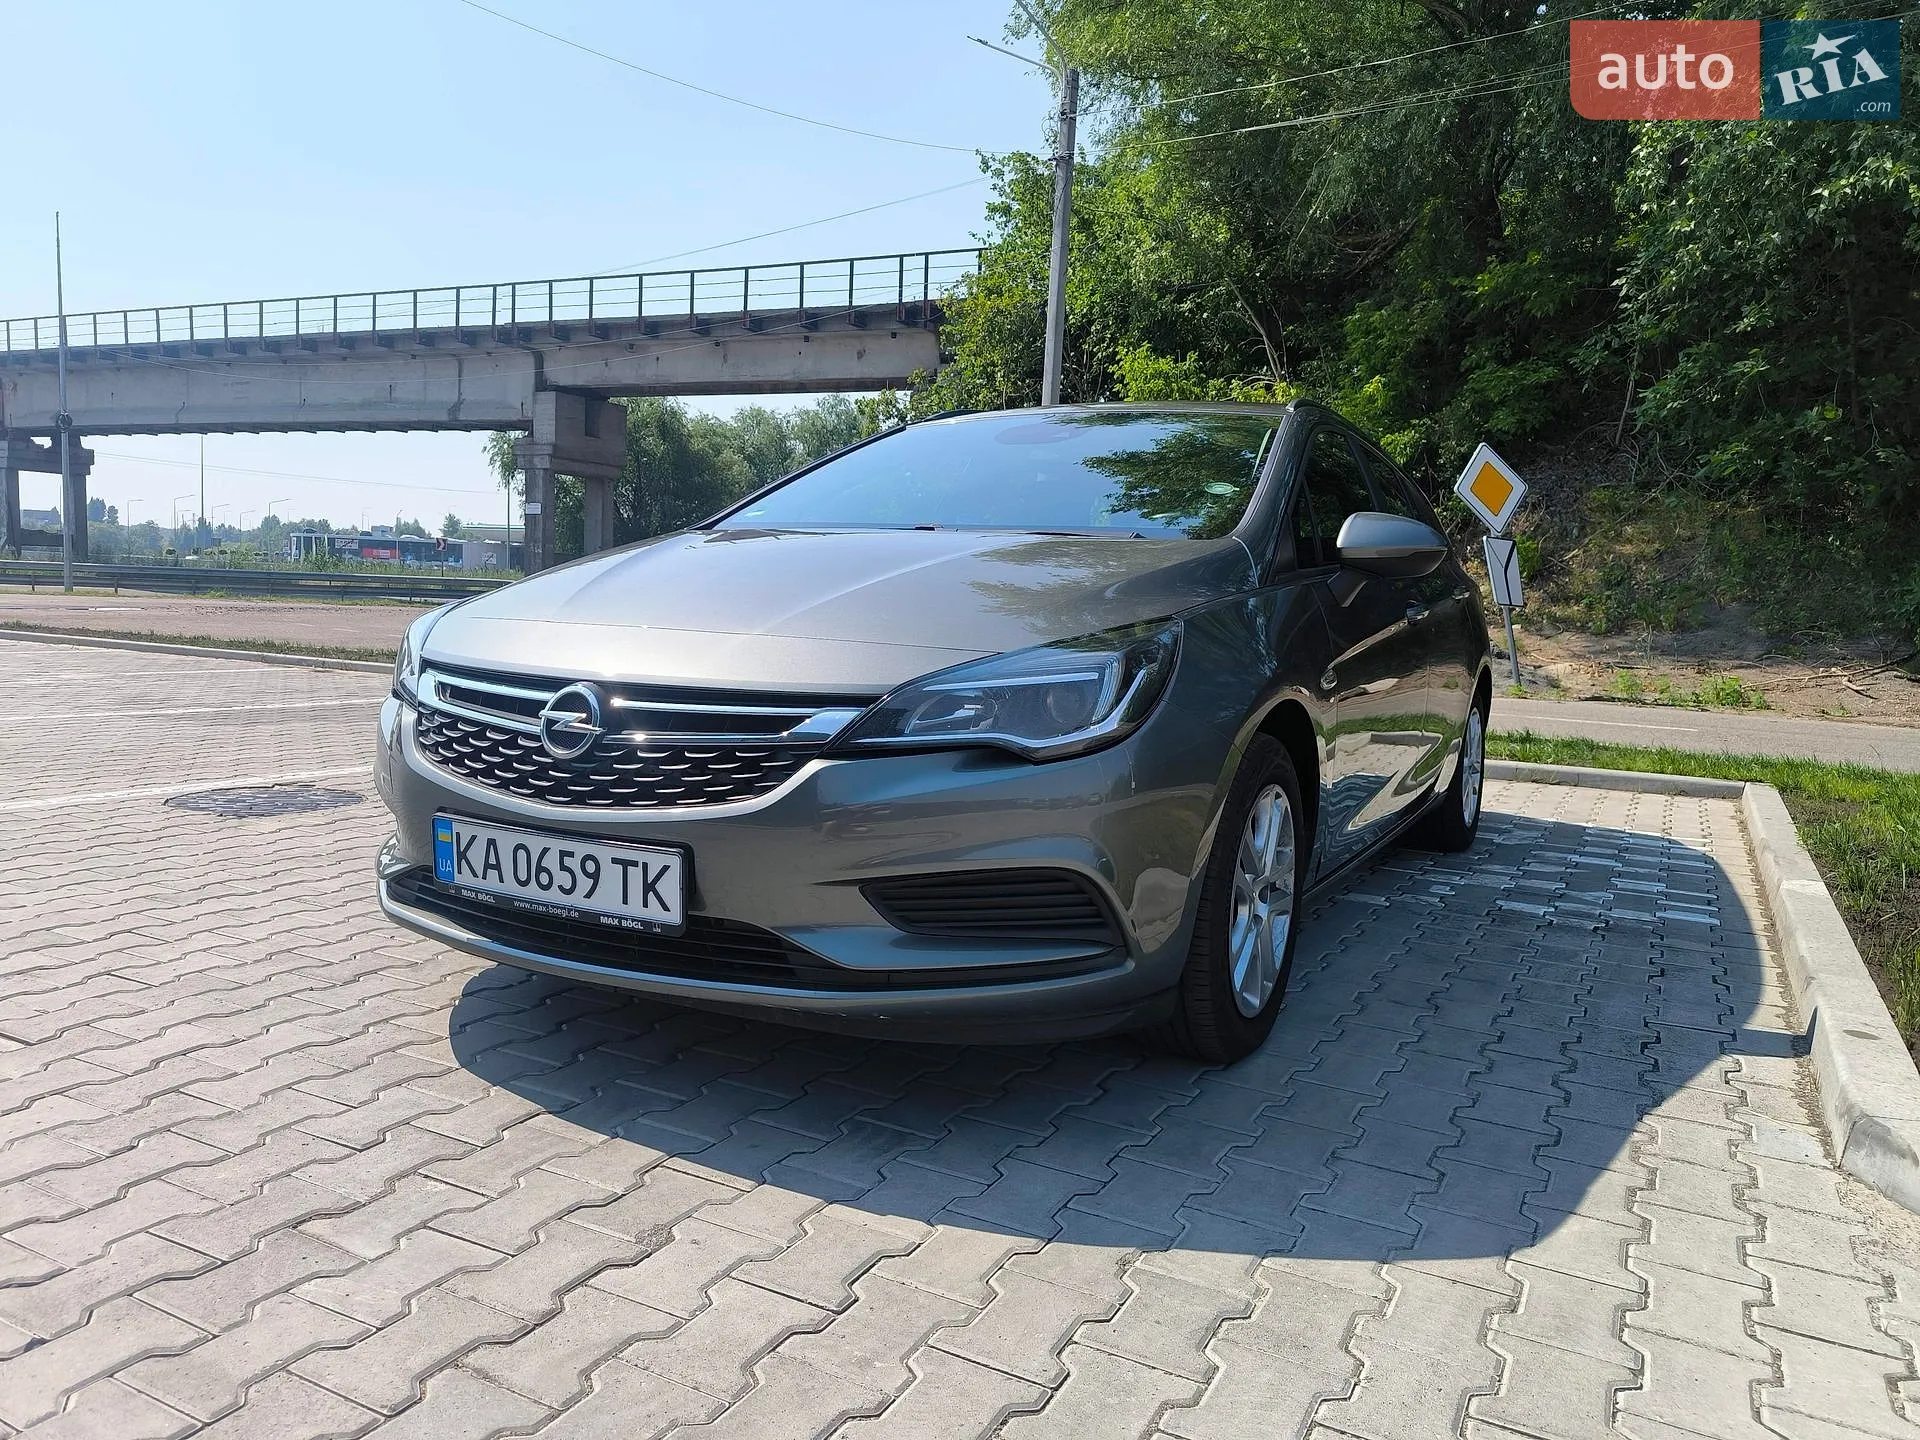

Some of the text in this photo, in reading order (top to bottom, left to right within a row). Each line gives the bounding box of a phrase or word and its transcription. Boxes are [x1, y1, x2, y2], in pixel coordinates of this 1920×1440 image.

[439, 858, 453, 873] UA
[455, 831, 671, 912] KA 0659 TK
[461, 888, 476, 899] MAX
[600, 916, 644, 930] MAX BÖGL
